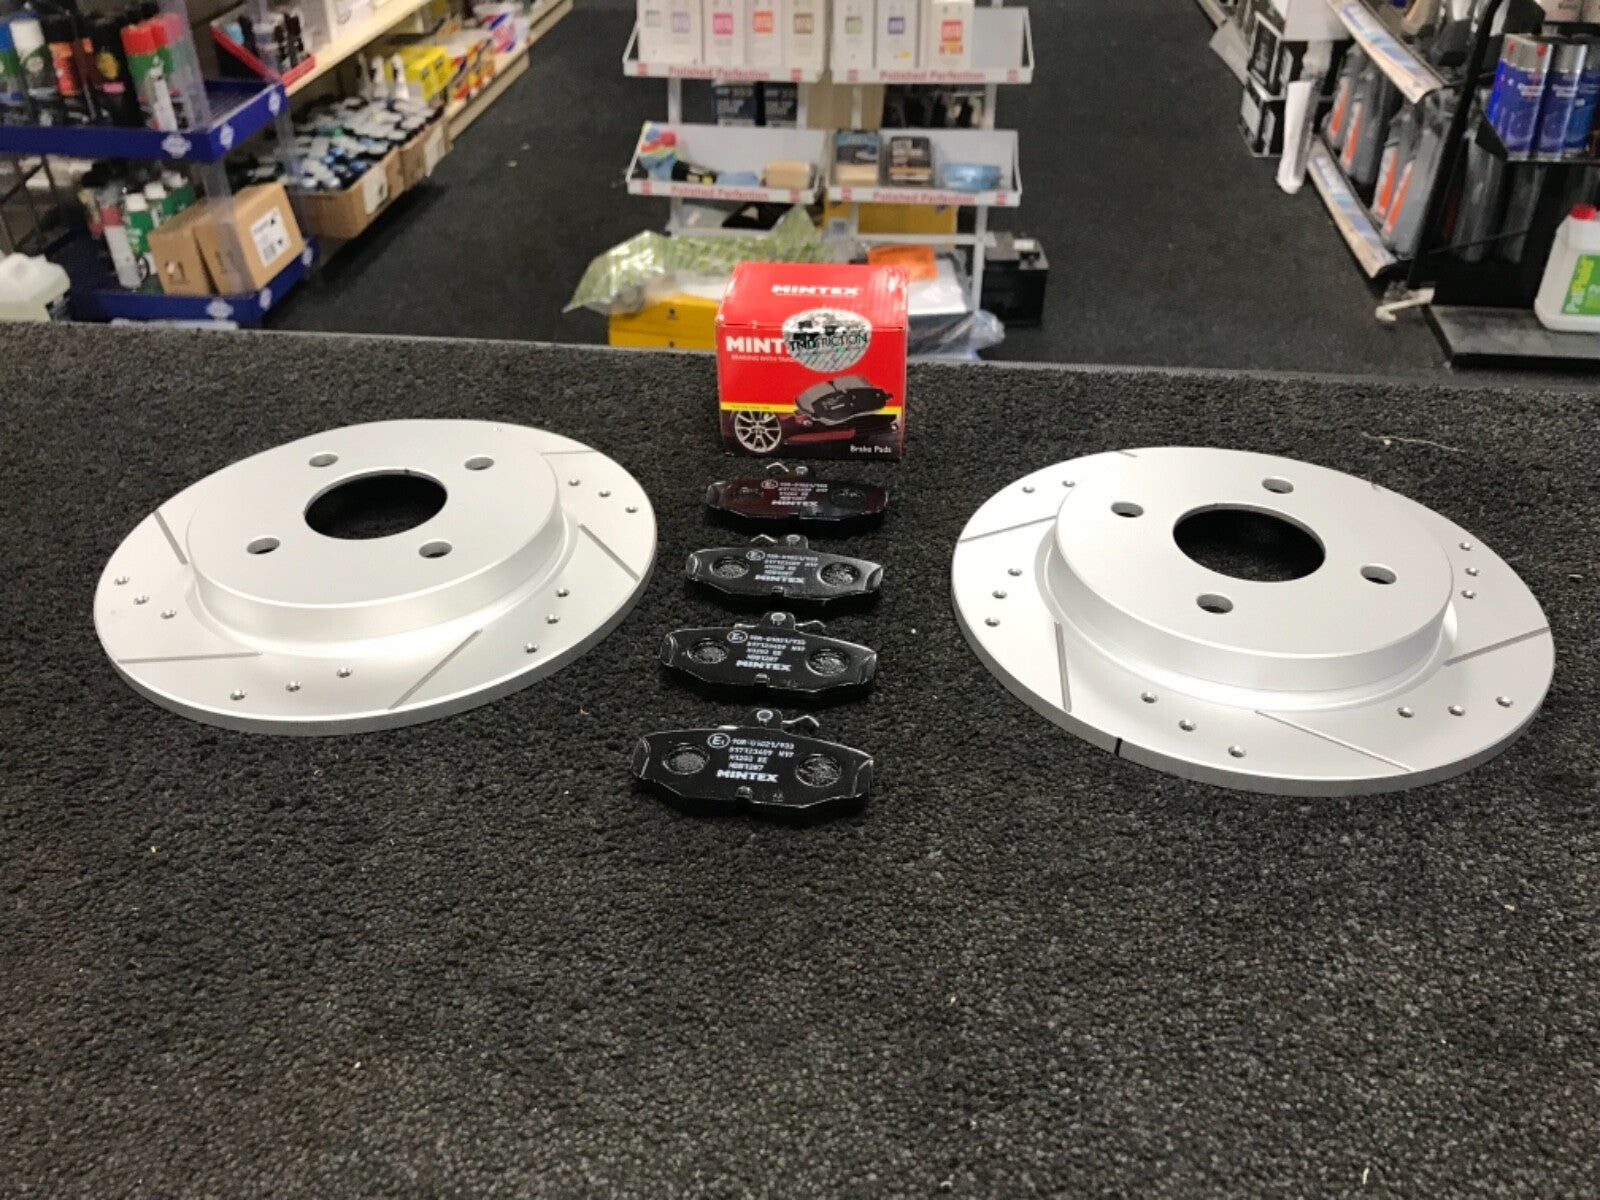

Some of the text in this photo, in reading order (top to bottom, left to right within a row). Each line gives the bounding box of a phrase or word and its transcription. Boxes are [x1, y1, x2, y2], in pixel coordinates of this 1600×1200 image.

[668, 66, 770, 81] Polished Perfection
[880, 69, 985, 81] Polished Perfection
[671, 185, 769, 201] Polished Perfection
[873, 191, 975, 205] Polished Perfection
[771, 285, 860, 296] MINTEX
[726, 336, 788, 354] MINT
[850, 445, 892, 453] Brake Pads
[754, 574, 805, 584] MINTEX
[736, 660, 792, 672] MINTEX
[716, 769, 779, 783] MINTEX
